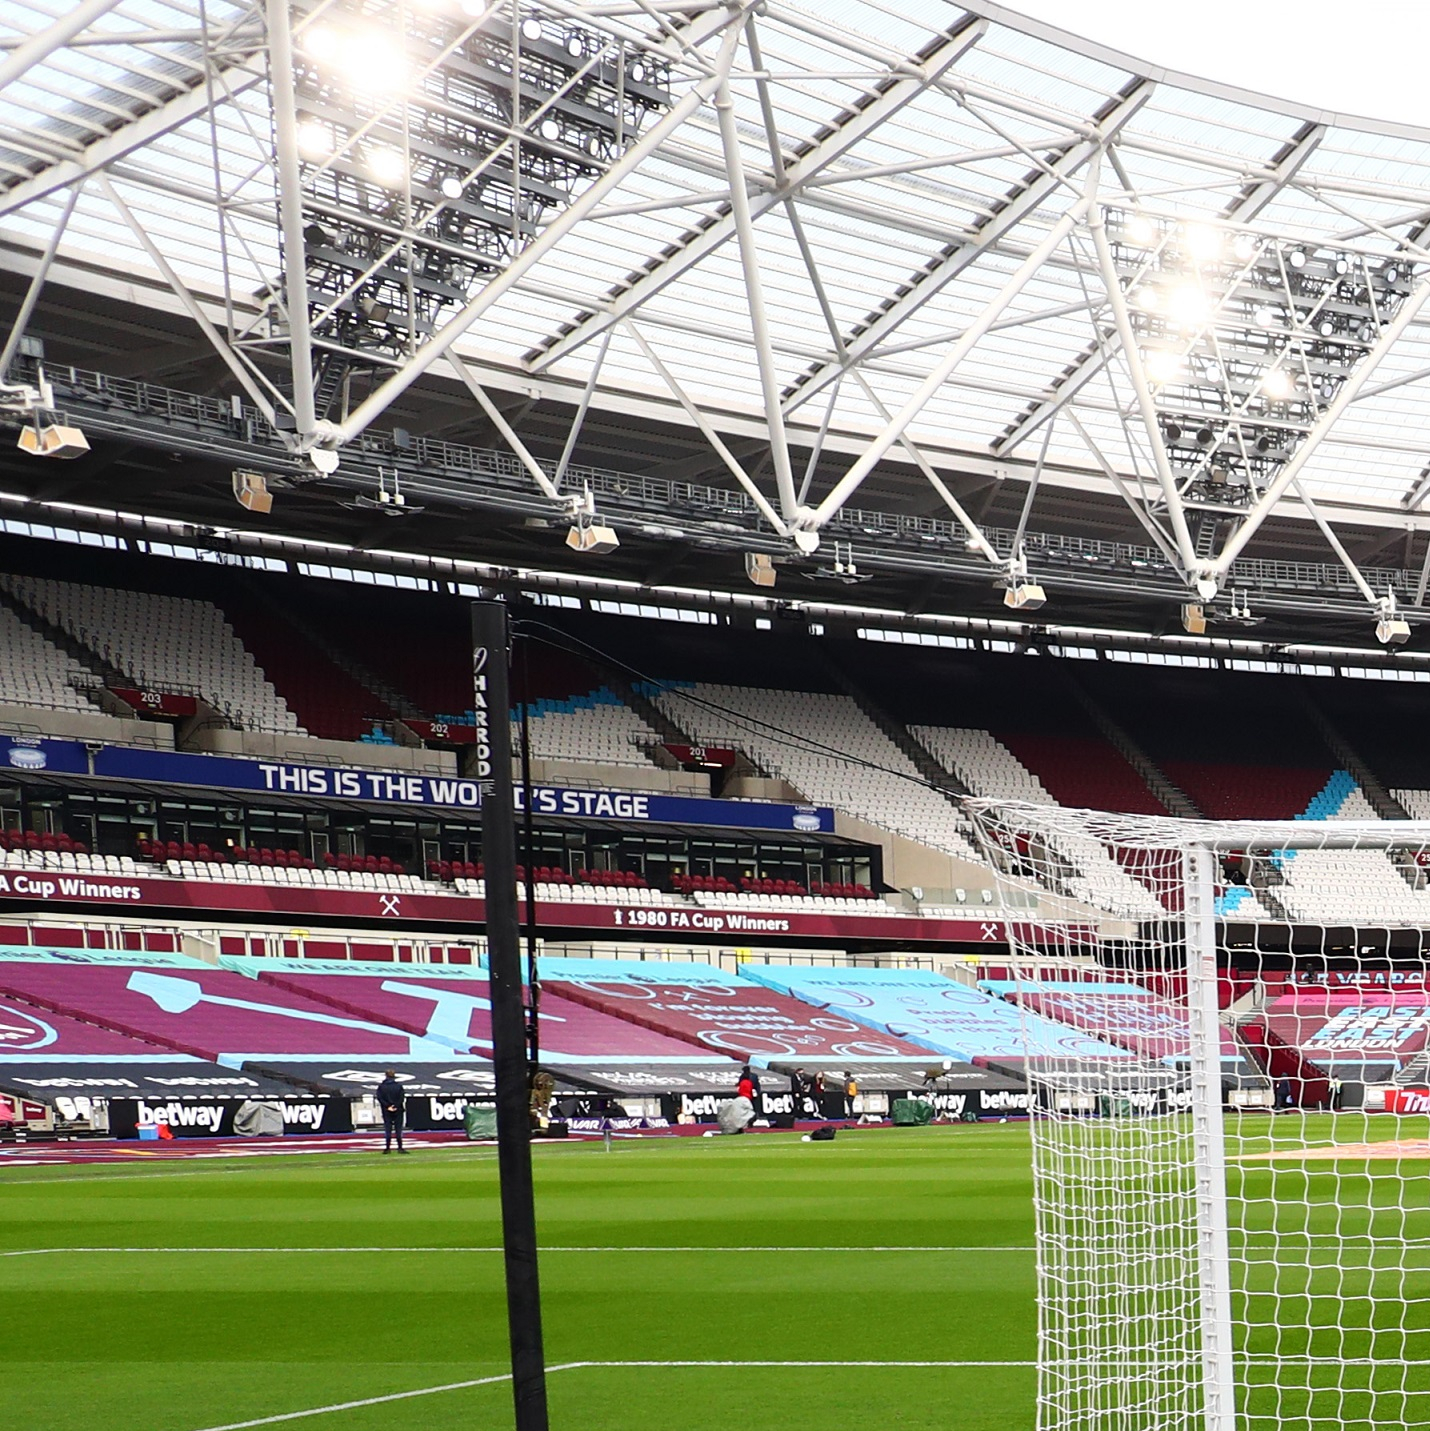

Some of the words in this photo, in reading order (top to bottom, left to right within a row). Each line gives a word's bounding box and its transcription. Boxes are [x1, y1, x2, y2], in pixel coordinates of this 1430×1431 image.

[140, 692, 161, 704] 203
[430, 723, 449, 734] 202
[473, 675, 492, 777] HARROD
[689, 747, 706, 757] 201
[259, 764, 327, 794] THIS
[334, 771, 361, 797] IS
[366, 774, 424, 802] THE
[562, 791, 649, 819] STAGE
[14, 875, 55, 898] Cup
[58, 877, 141, 900] Winners
[628, 910, 667, 927] 1980
[671, 912, 690, 928] FA
[692, 913, 723, 932] Cup
[727, 915, 789, 932] Winners
[1301, 1039, 1406, 1048] LONDON
[1310, 1028, 1424, 1039] EAST
[980, 1090, 1037, 1113] betway
[138, 1100, 224, 1132] betway
